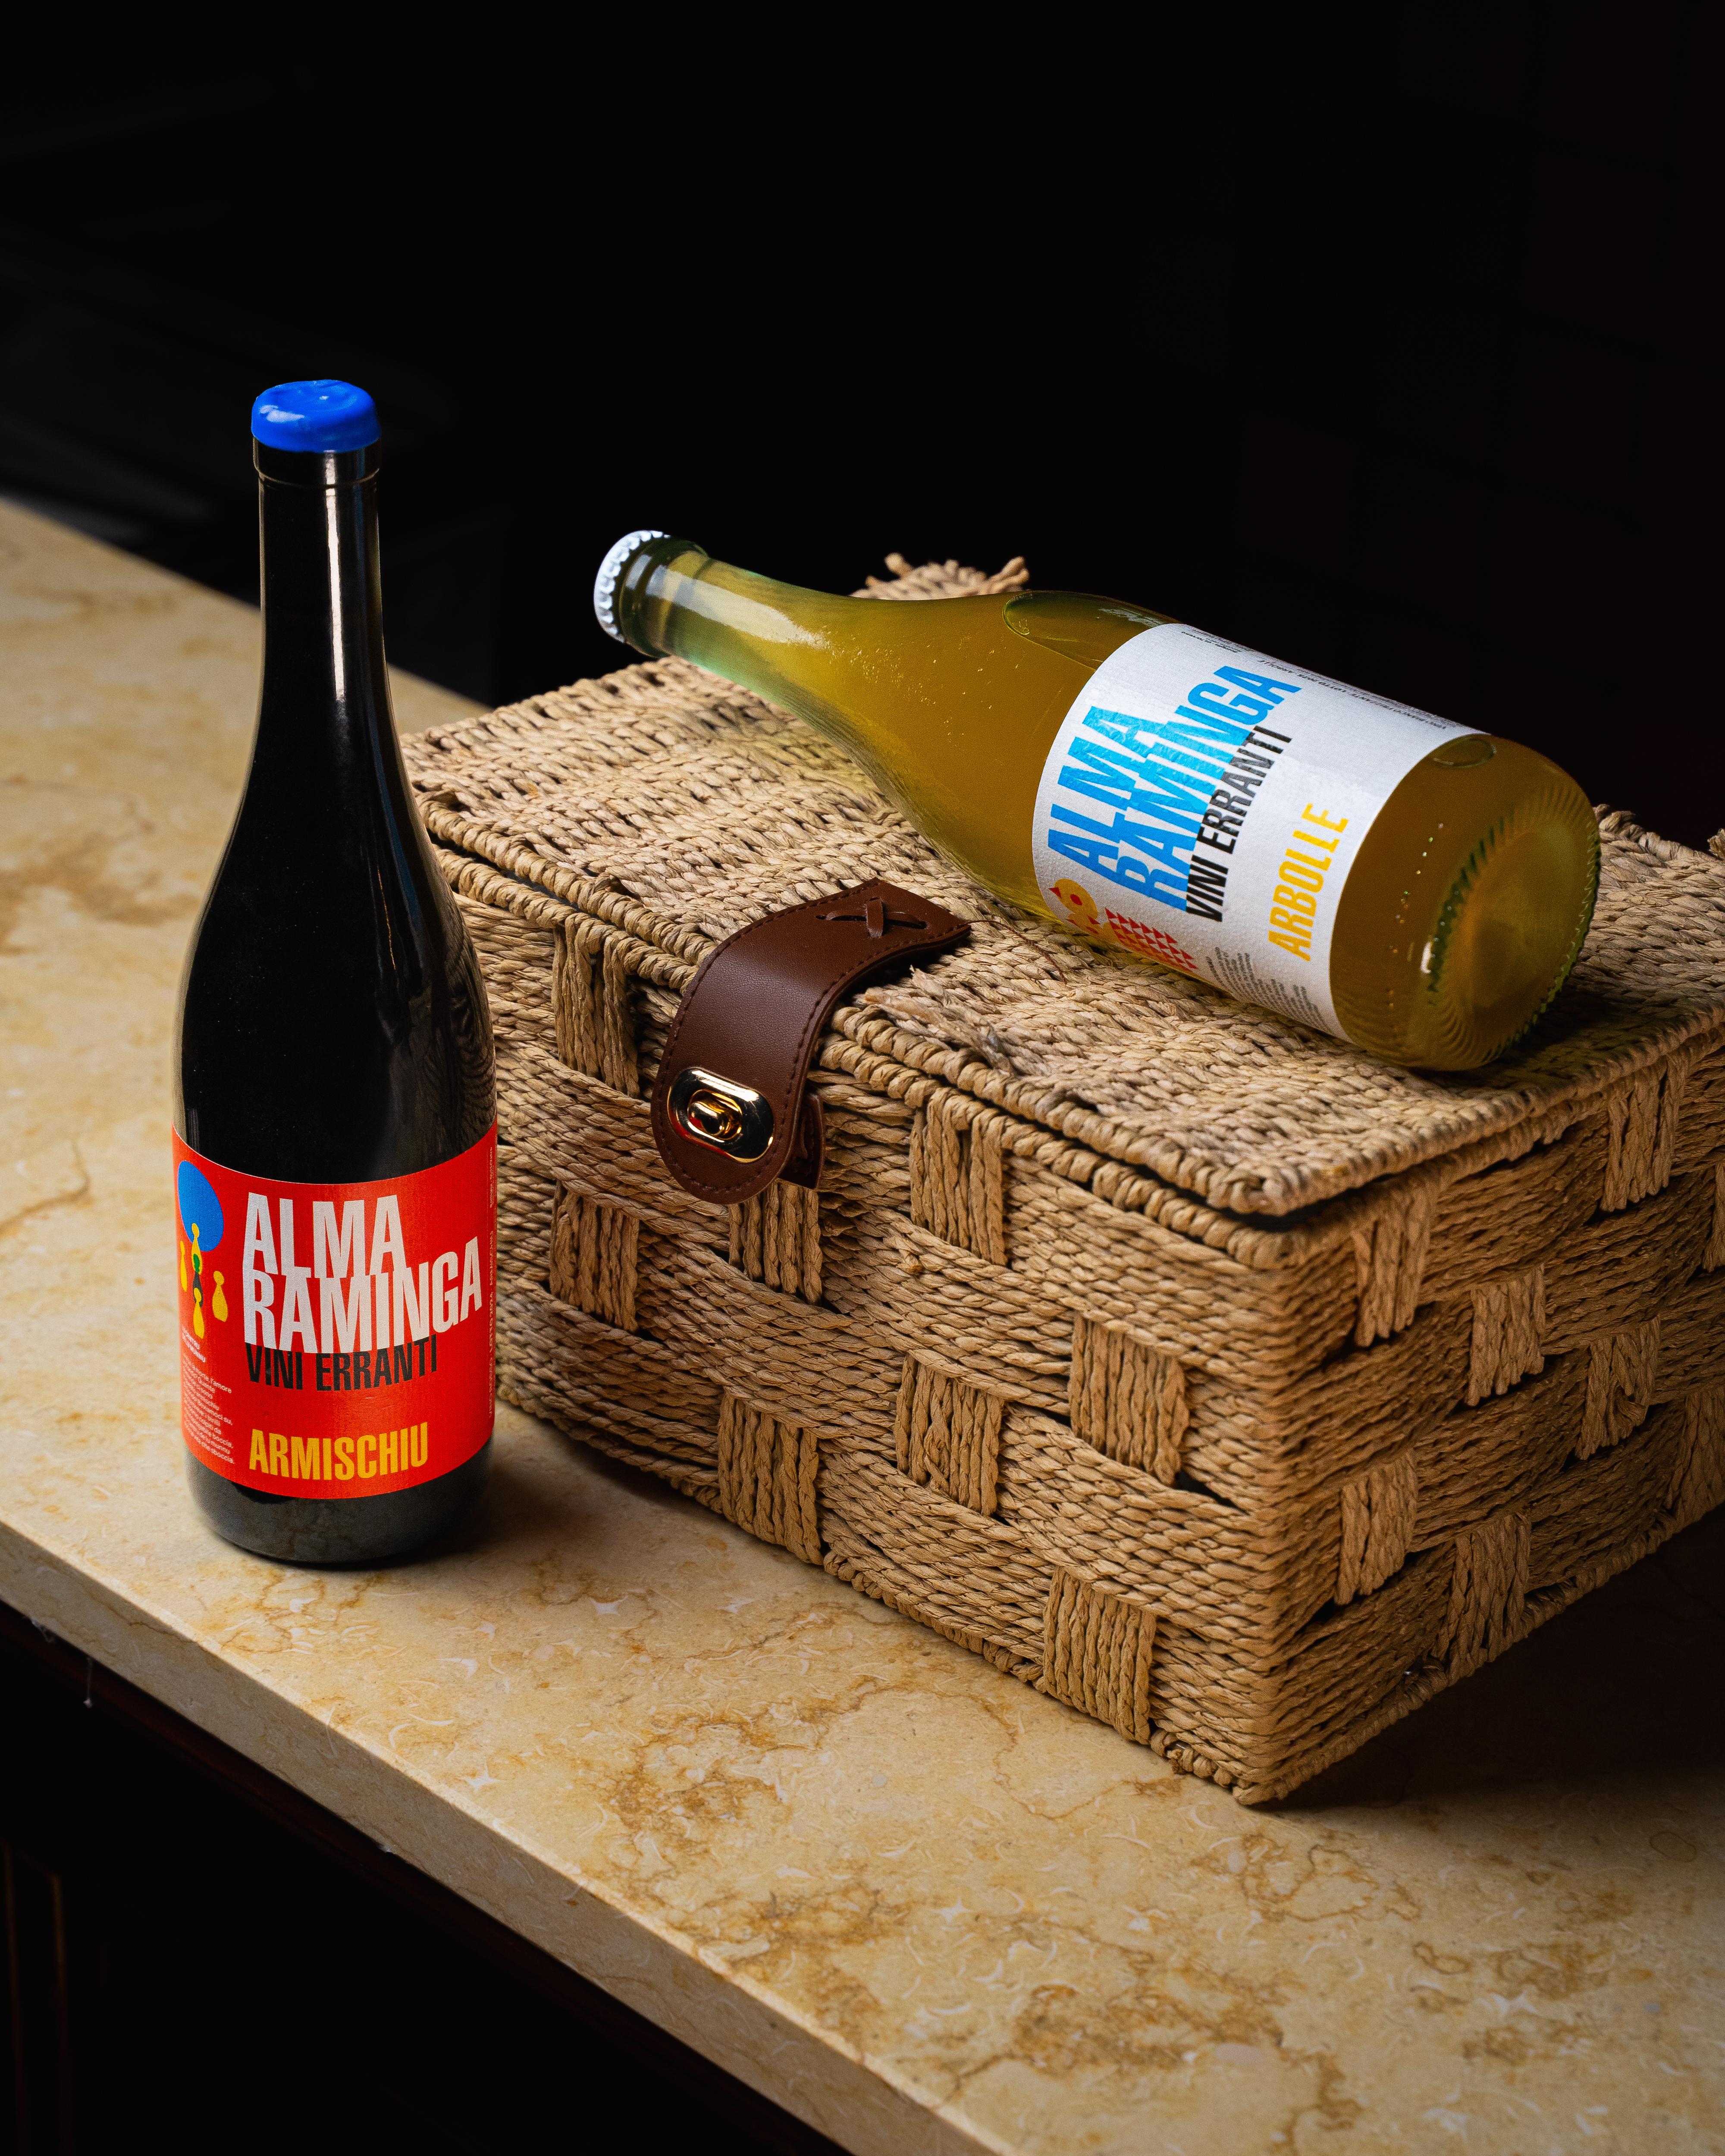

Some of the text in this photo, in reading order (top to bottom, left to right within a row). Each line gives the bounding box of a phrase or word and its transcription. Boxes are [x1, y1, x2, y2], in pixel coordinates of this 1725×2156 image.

[1258, 660, 1295, 674] ARBOLLE
[1318, 681, 1347, 693] LOTTO
[1048, 706, 1167, 874] ALMA
[1116, 665, 1302, 912] RAMINGA
[1196, 725, 1292, 854] ERRANTI
[1185, 854, 1228, 922] VINI
[1268, 804, 1349, 962] ARBOLLE
[244, 1192, 407, 1278] ALMA
[242, 1236, 482, 1354] RAMINGA
[245, 1342, 303, 1390] VINI
[316, 1334, 437, 1391] ERRANTI
[249, 1423, 427, 1480] ARMISCHIU
